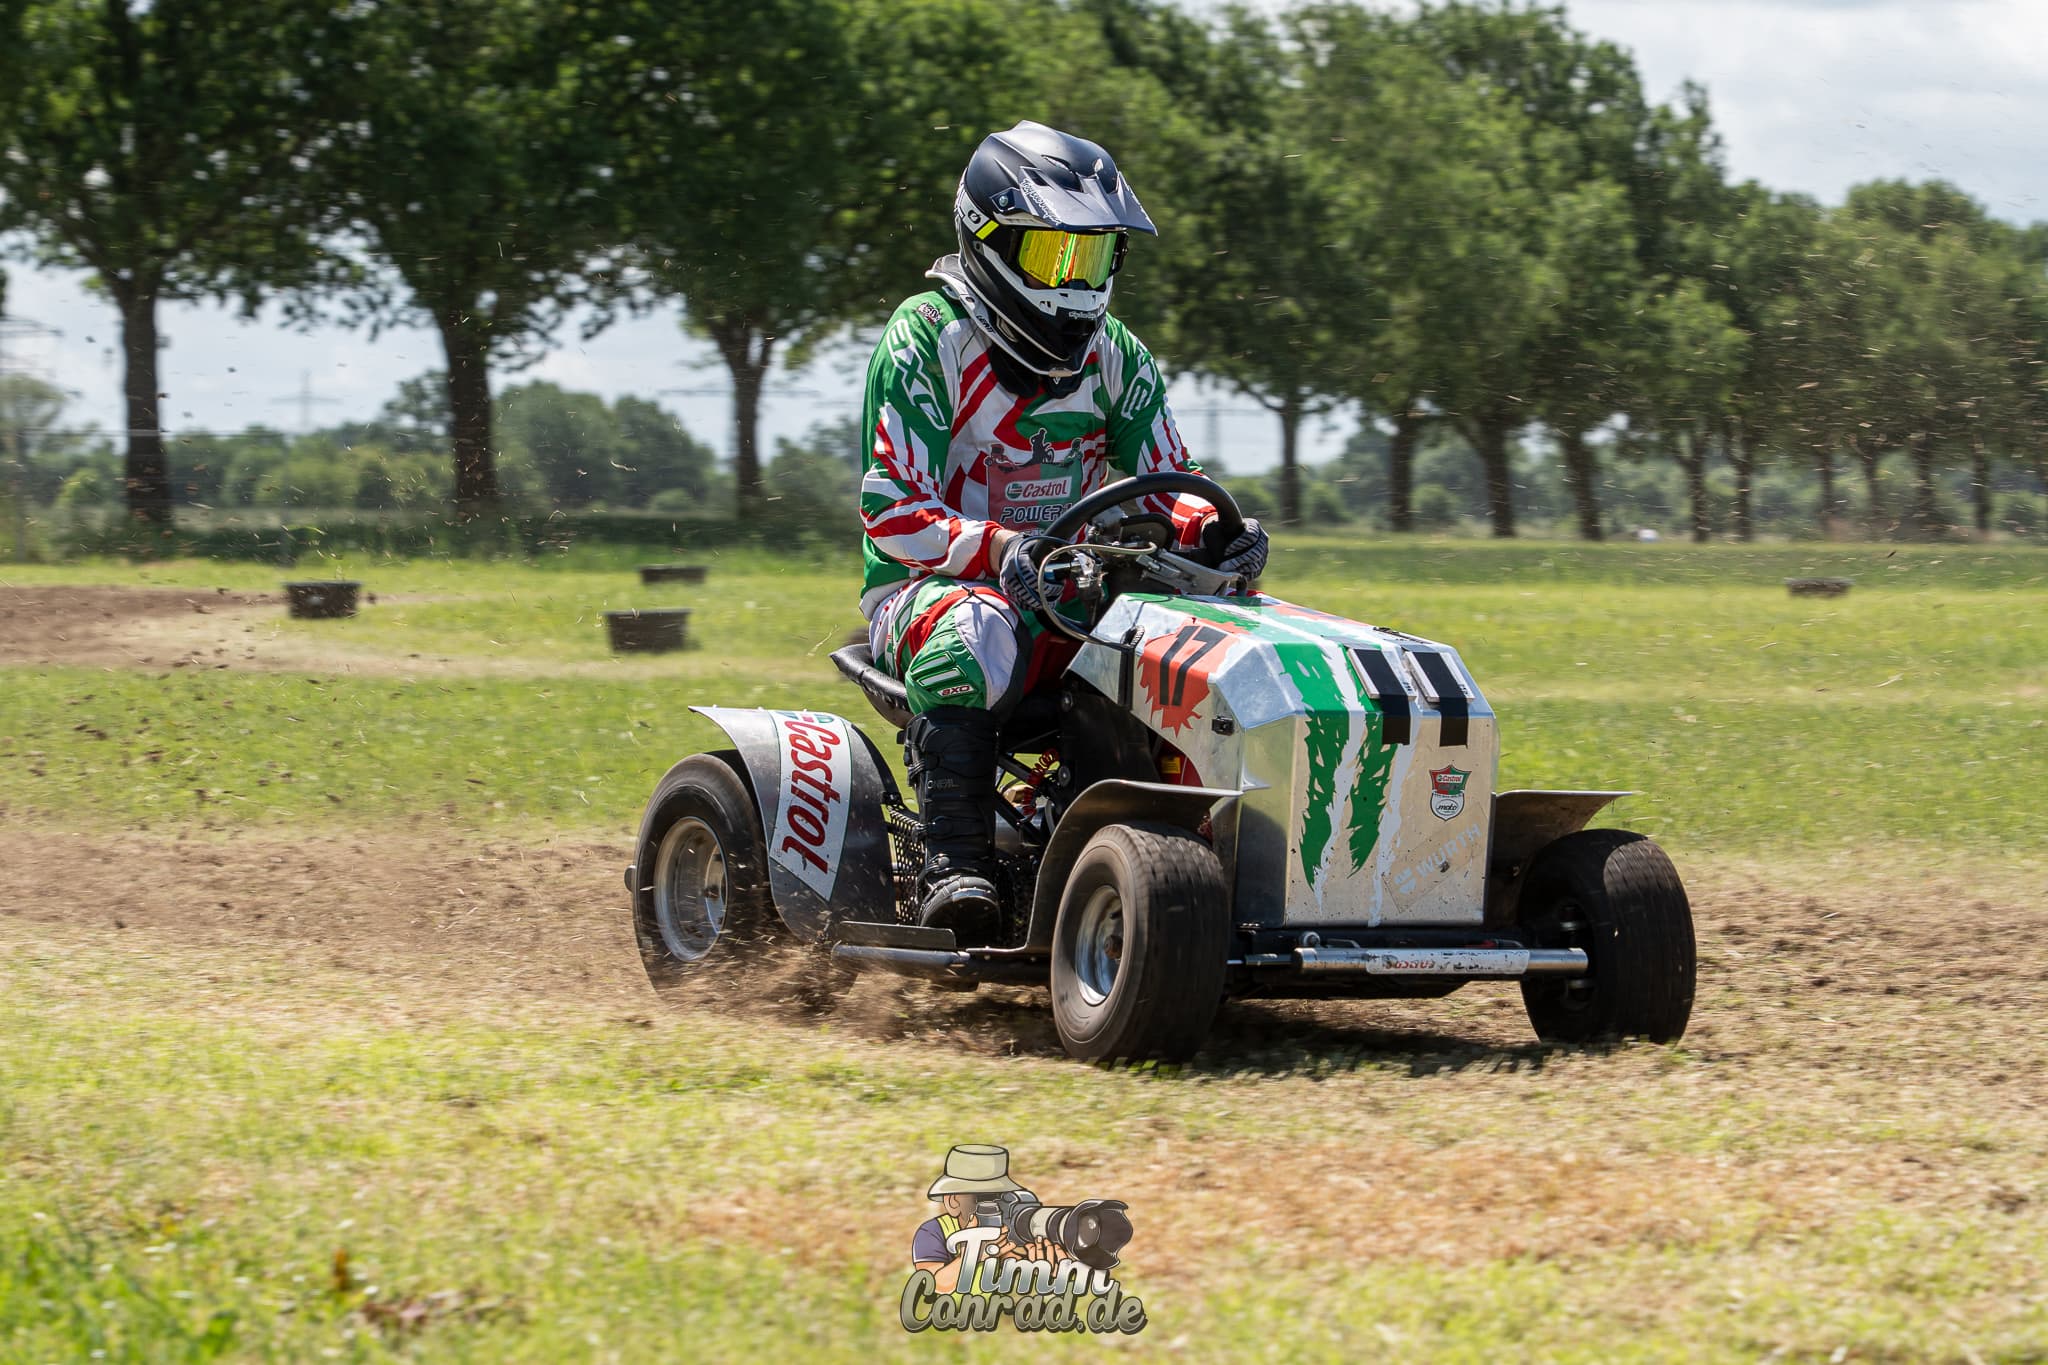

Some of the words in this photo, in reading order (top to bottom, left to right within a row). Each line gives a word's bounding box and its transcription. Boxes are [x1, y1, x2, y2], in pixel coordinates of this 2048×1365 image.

[1022, 479, 1068, 498] Castrol
[1159, 625, 1229, 707] 17
[782, 719, 841, 875] Castrol
